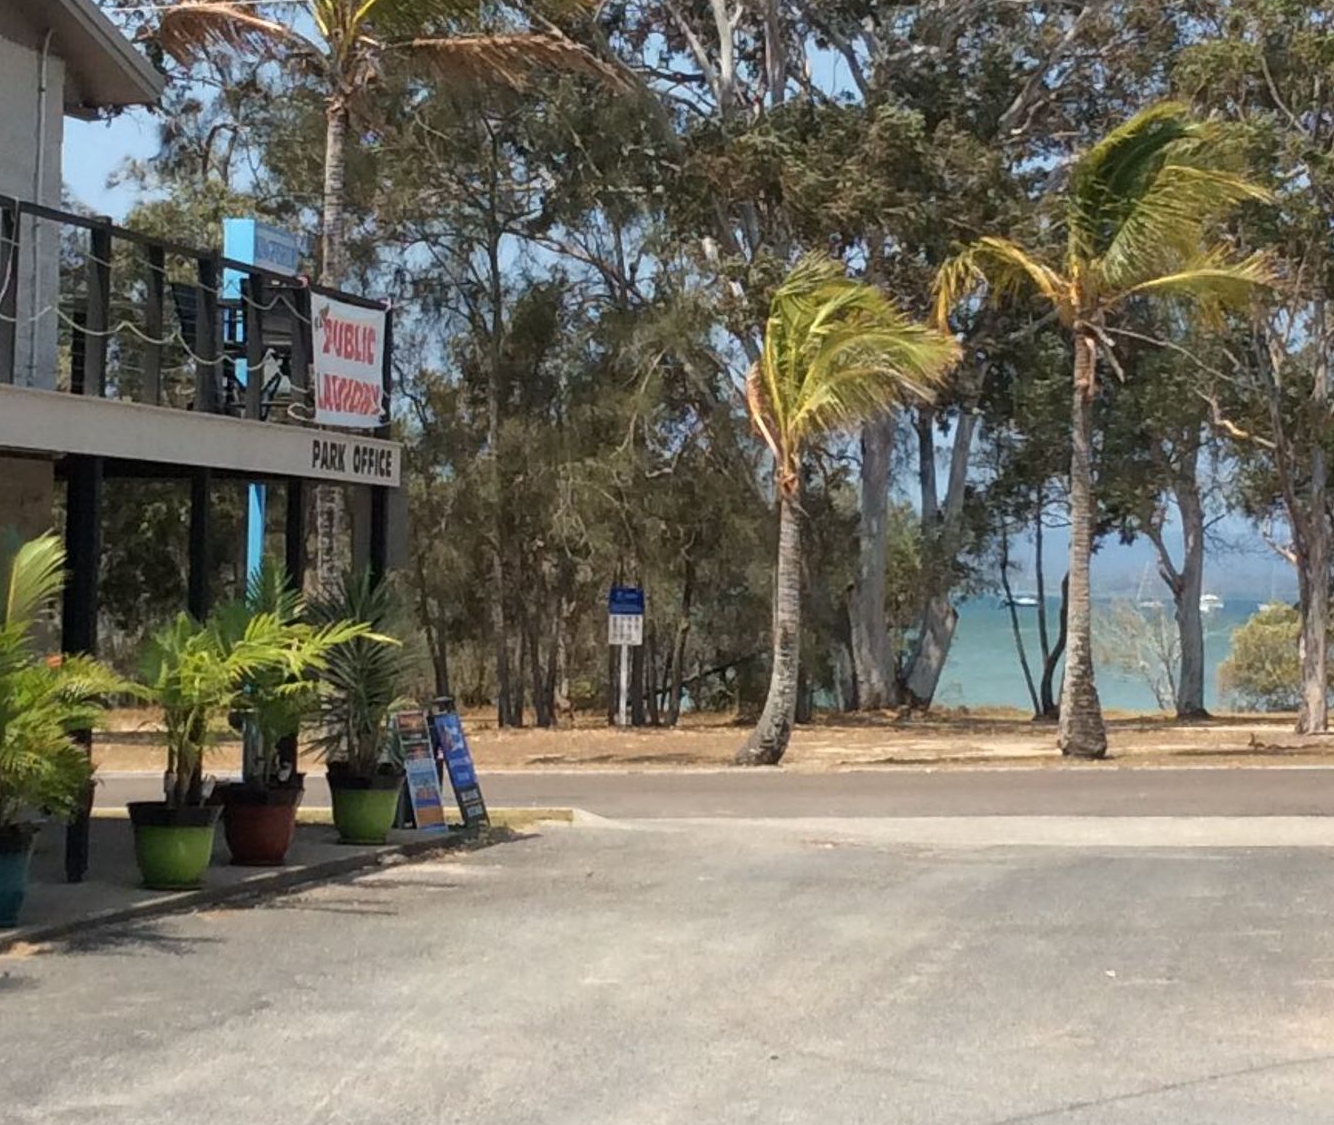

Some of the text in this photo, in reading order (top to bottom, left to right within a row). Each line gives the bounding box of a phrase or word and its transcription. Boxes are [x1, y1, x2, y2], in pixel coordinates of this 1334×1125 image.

[323, 318, 376, 365] PUBLIC
[317, 373, 380, 416] LAUNDRY
[312, 439, 392, 478] PARK OFFICE
